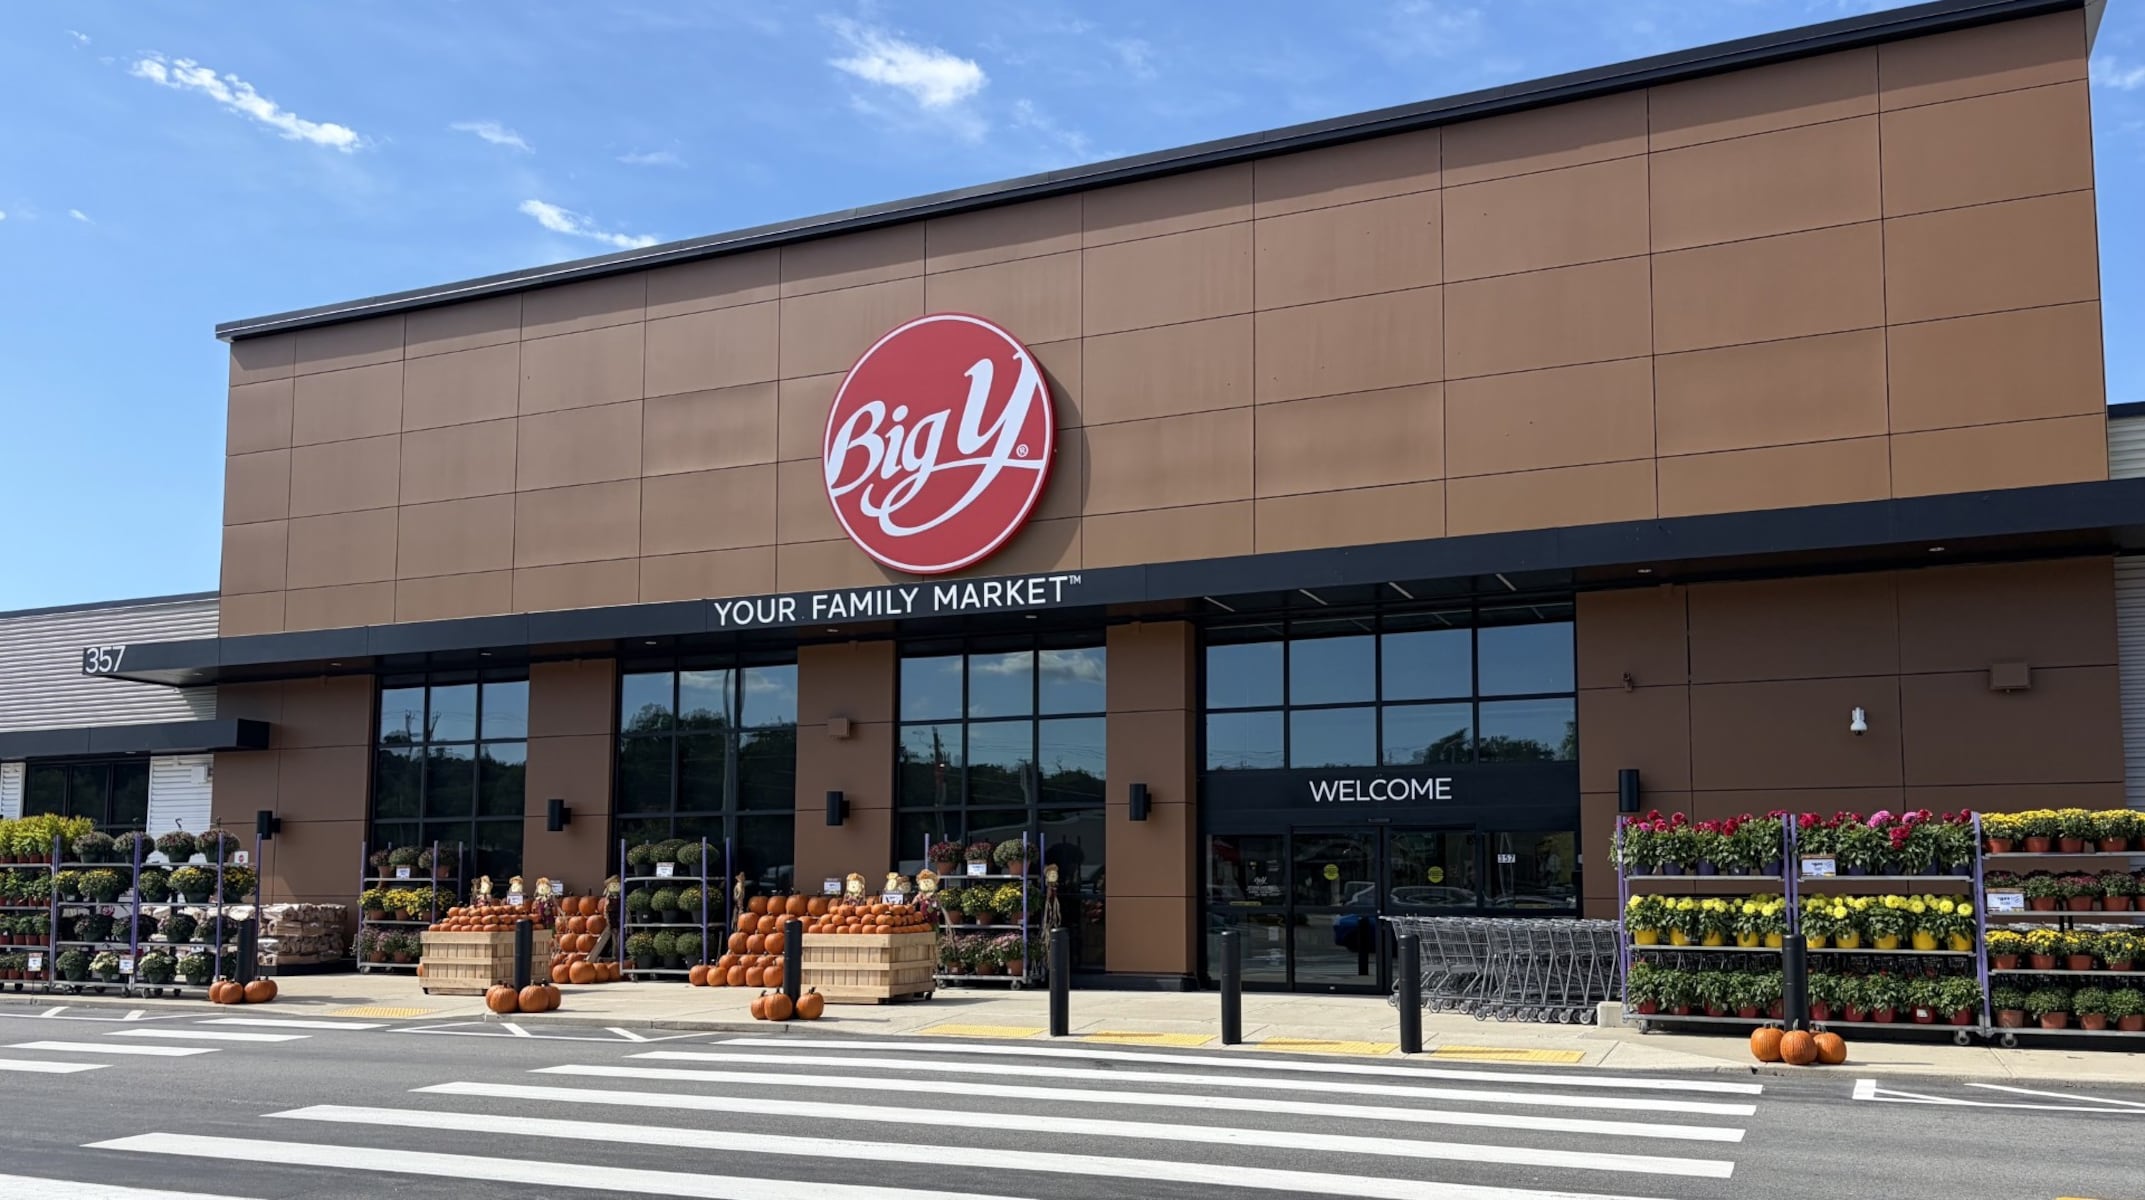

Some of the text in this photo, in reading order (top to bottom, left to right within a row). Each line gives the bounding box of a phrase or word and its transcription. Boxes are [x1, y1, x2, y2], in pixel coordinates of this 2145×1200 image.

[827, 400, 951, 517] Big
[714, 596, 796, 626] YOUR
[812, 587, 919, 620] FAMILY
[85, 645, 126, 674] 357
[1309, 777, 1452, 802] WELCOME
